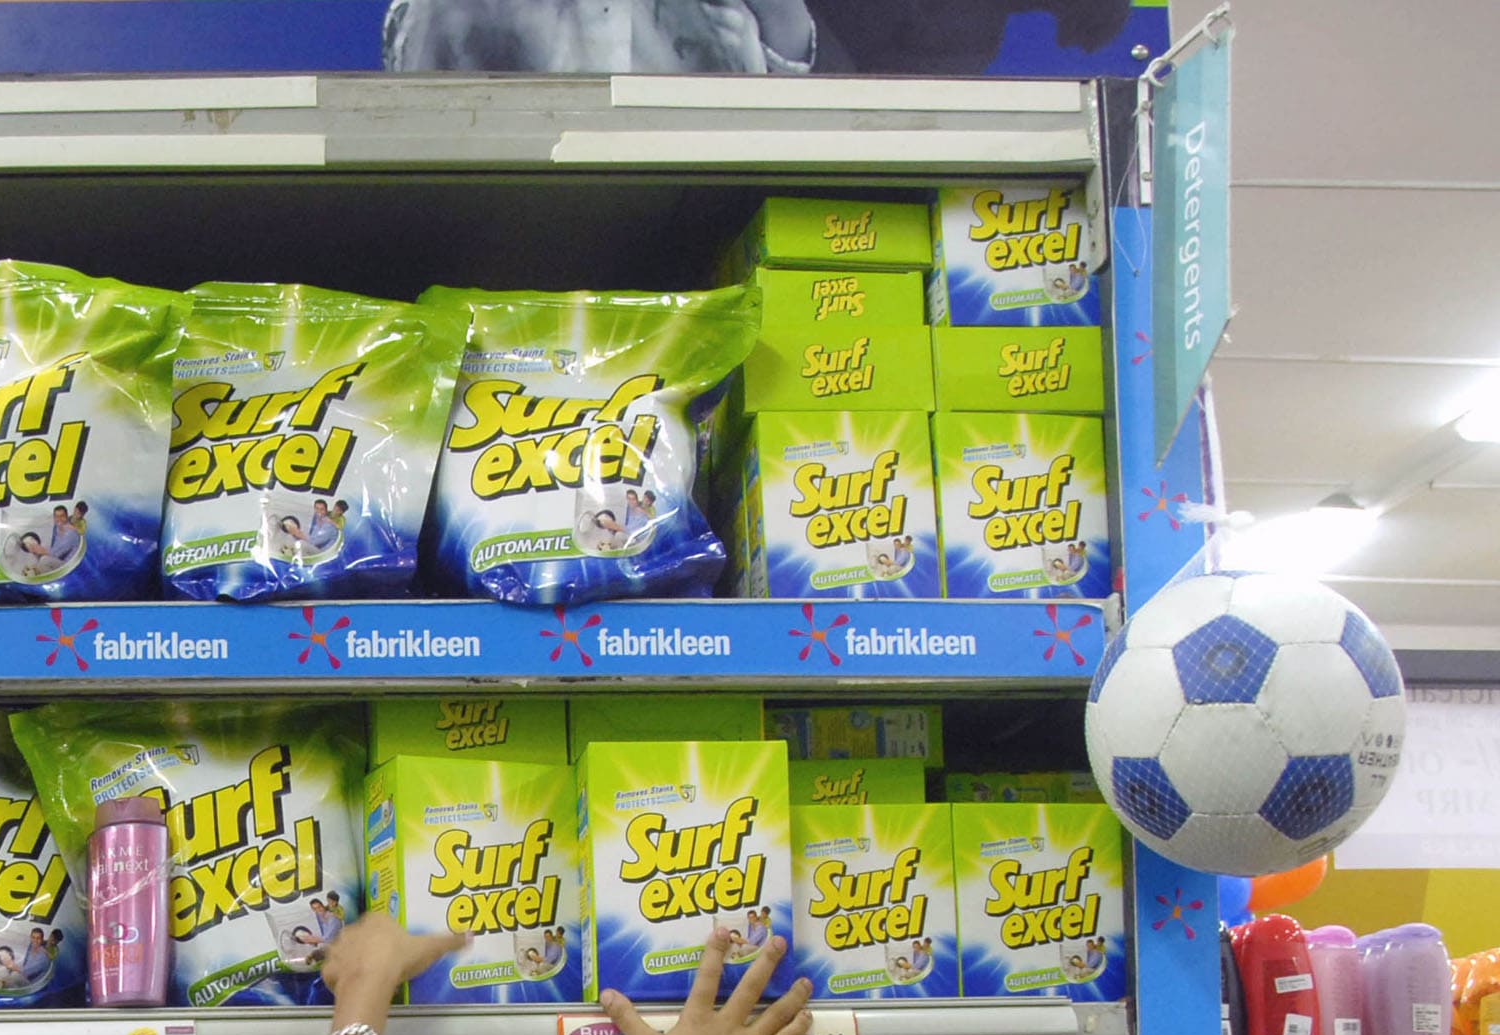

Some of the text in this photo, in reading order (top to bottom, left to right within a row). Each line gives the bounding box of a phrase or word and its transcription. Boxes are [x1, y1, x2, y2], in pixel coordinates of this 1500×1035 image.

[822, 209, 873, 239] Surf
[968, 189, 1073, 242] Surf
[1178, 120, 1207, 351] Detergents
[830, 230, 877, 254] excel
[984, 223, 1082, 271] excel
[801, 337, 870, 378] Surf
[810, 363, 875, 398] excel
[998, 337, 1066, 378] Surf
[1007, 363, 1071, 398] excel
[169, 362, 367, 455] Surf
[447, 374, 665, 455] Surf
[166, 427, 357, 503] excel
[471, 414, 660, 500] excel
[790, 450, 900, 518] Surf
[967, 454, 1077, 519] Surf
[805, 494, 908, 550] excel
[983, 499, 1081, 550] excel
[165, 537, 257, 568] AUTOMATIC
[473, 534, 572, 567] AUTOMATIC
[813, 569, 869, 587] AUTOMATIC
[990, 571, 1045, 588] AUTOMATIC
[93, 632, 229, 661] fabrikleen
[345, 630, 481, 658] fabrikleen
[596, 628, 731, 656] fabrikleen
[844, 627, 977, 657] fabrikleen
[435, 699, 503, 731] Surf
[445, 717, 509, 751] excel
[90, 760, 132, 792] Removes
[811, 769, 866, 802] Surf
[428, 819, 554, 898] Surf
[619, 797, 759, 883] Surf
[167, 815, 321, 941] excel
[638, 854, 767, 922] excel
[808, 846, 921, 918] Surf
[985, 846, 1094, 918] Surf
[446, 874, 561, 937] excel
[824, 894, 928, 951] excel
[1000, 893, 1101, 950] excel
[194, 954, 282, 1006] AUTOMATIC
[453, 965, 514, 983] AUTOMATIC
[646, 950, 702, 970] AUTOMAT
[831, 972, 886, 989] AUTOMATIC
[1007, 971, 1062, 988] AUTOMATIC
